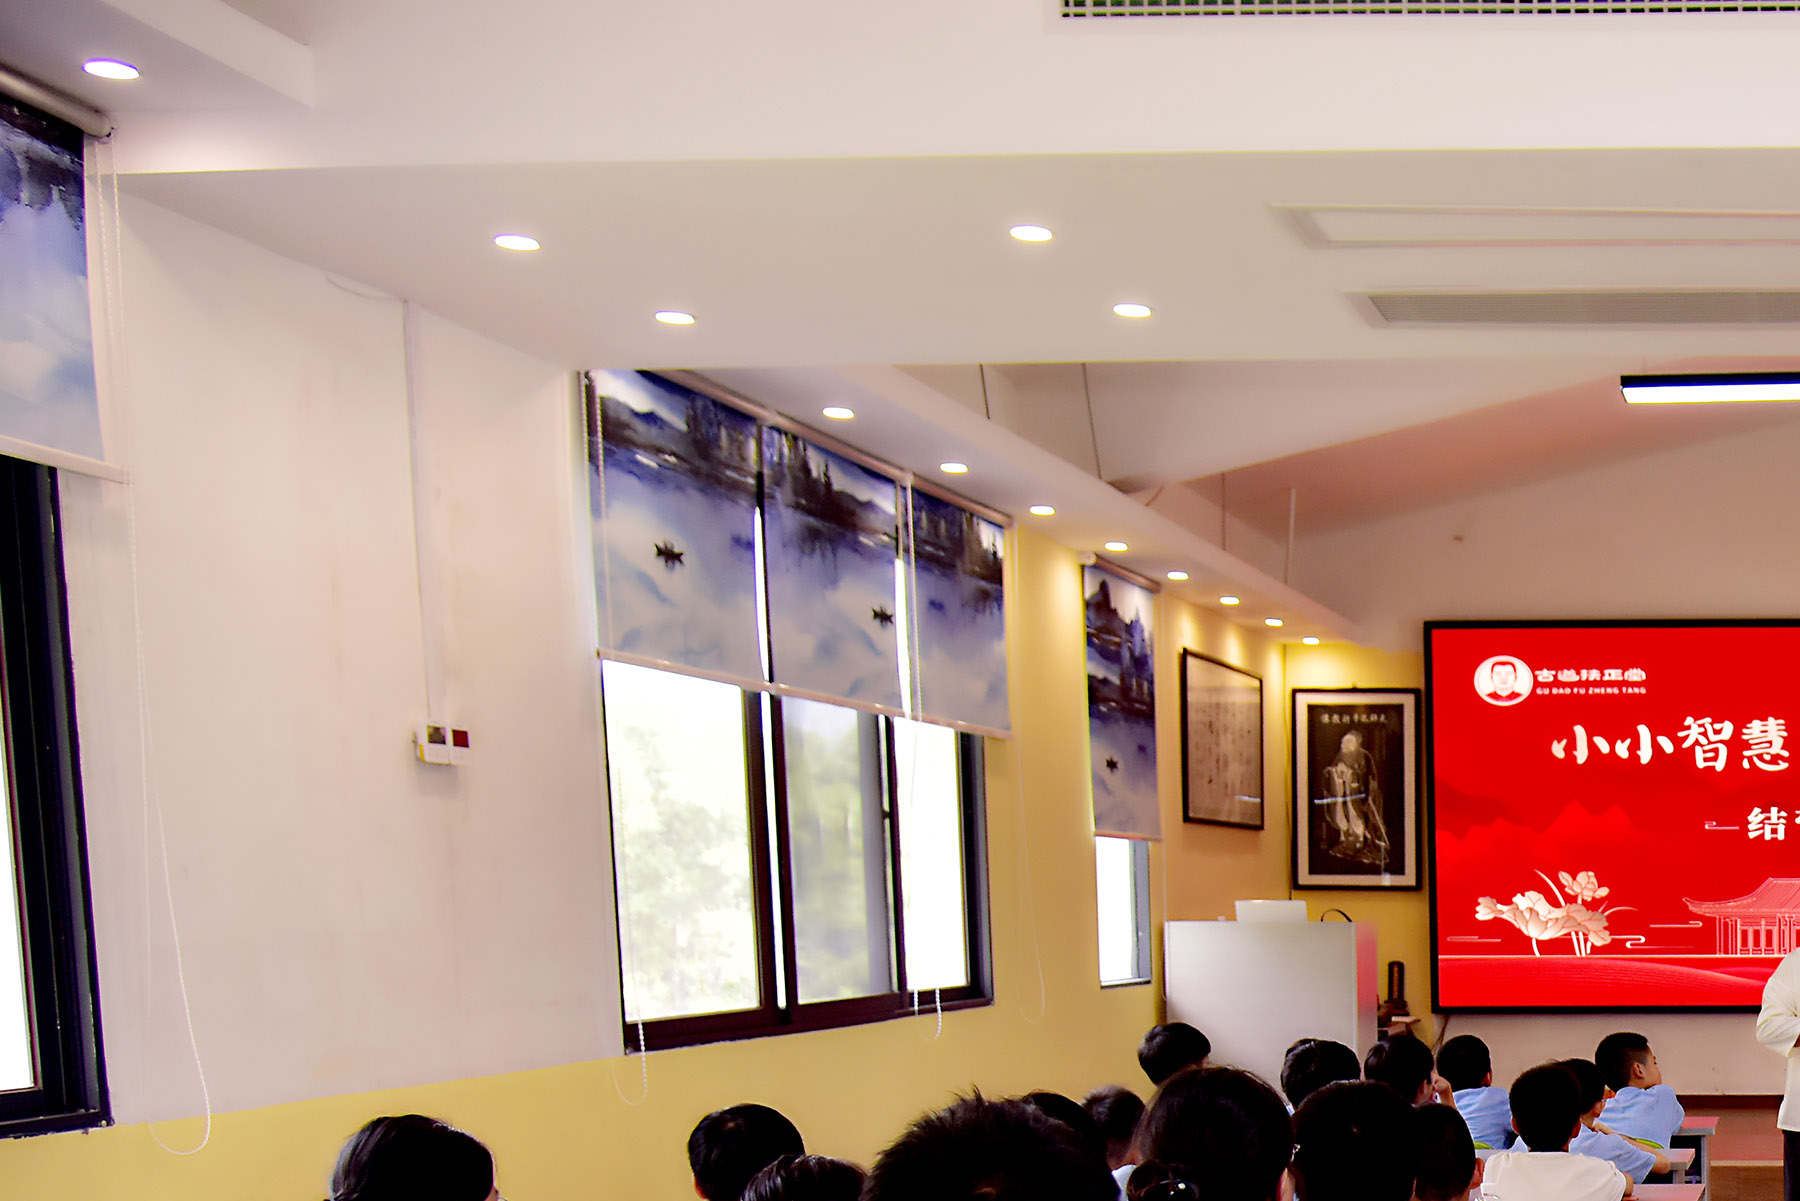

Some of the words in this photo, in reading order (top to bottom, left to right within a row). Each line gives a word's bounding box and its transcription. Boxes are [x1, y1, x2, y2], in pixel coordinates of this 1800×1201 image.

[1535, 686, 1550, 695] GU
[1551, 686, 1572, 695] DAO
[1573, 686, 1586, 695] FU
[1588, 686, 1620, 695] ZHENG
[1621, 686, 1647, 695] TANG
[1551, 716, 1790, 772] 小小智慧
